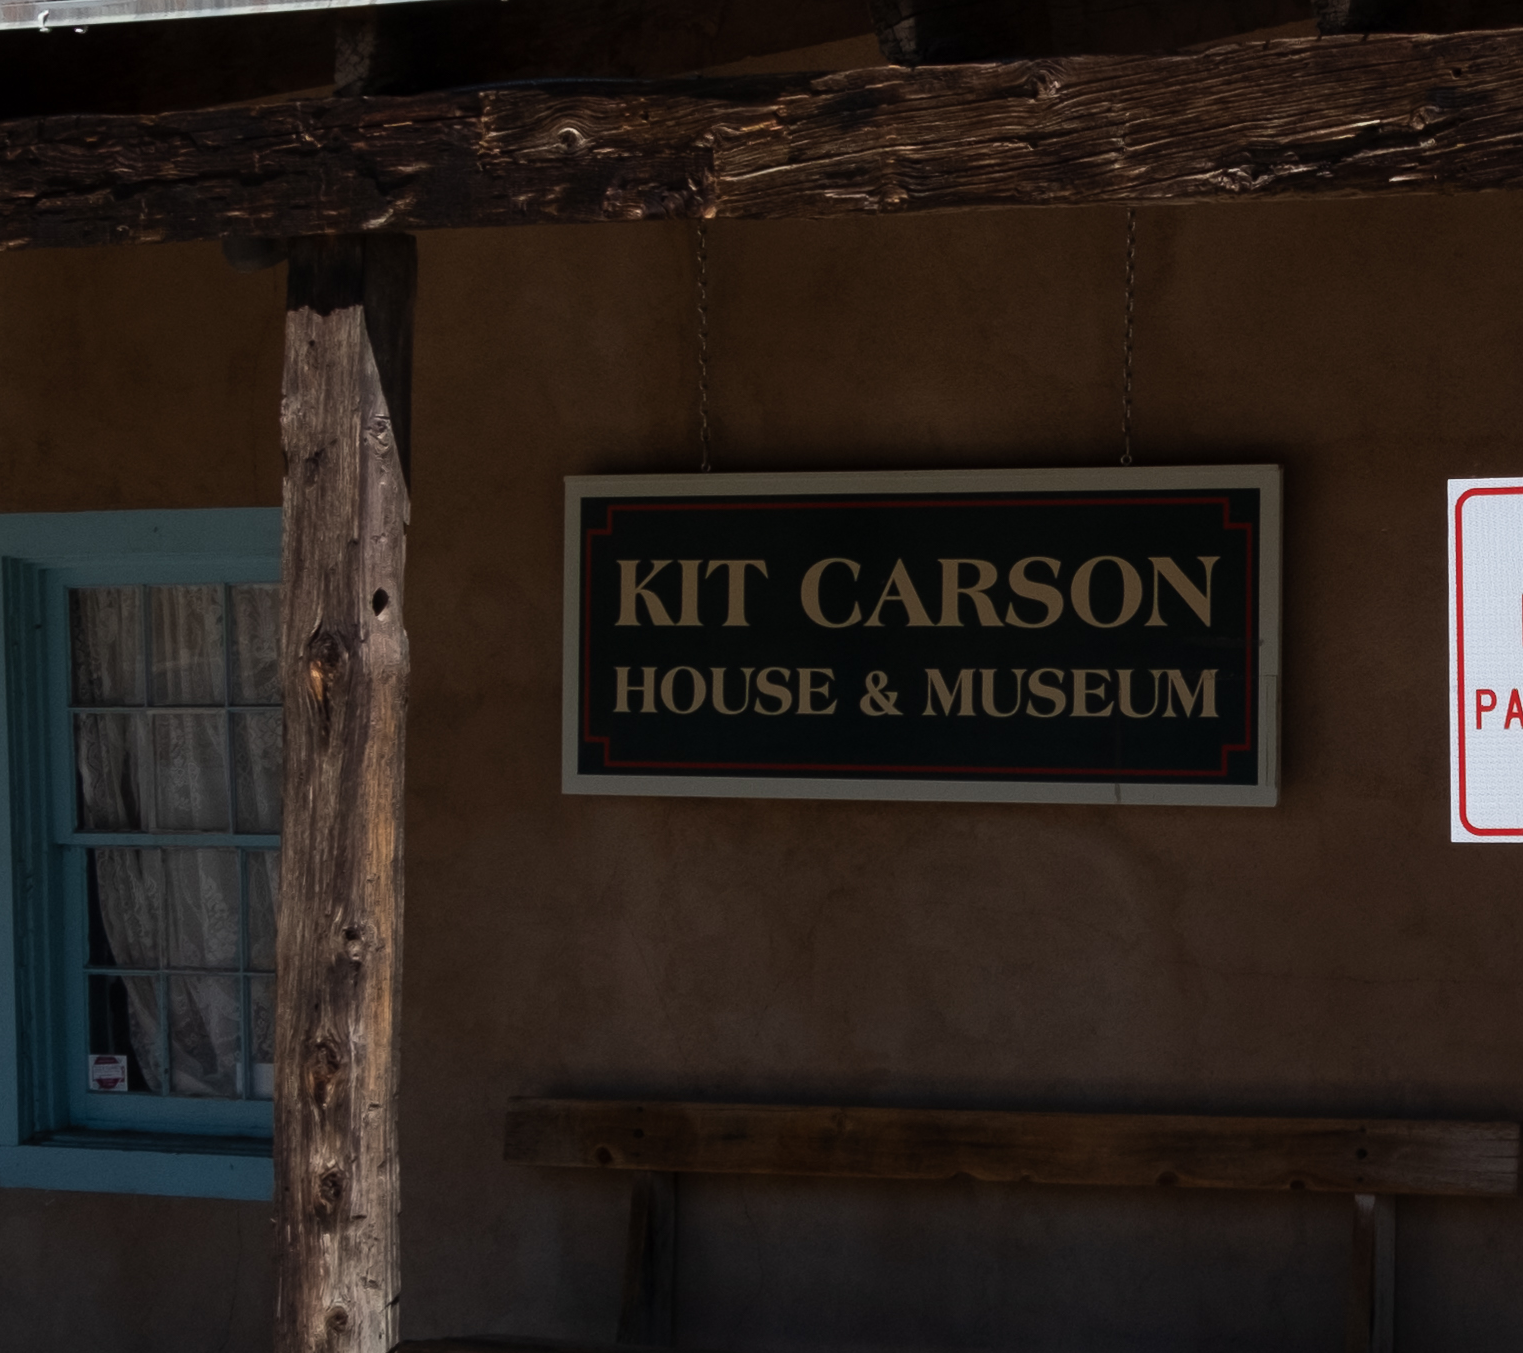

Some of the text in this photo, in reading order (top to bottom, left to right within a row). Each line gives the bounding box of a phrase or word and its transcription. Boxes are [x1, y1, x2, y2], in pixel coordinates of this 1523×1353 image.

[613, 552, 1222, 630] KIT CARSON
[613, 663, 1220, 721] HOUSE & MUSEUM
